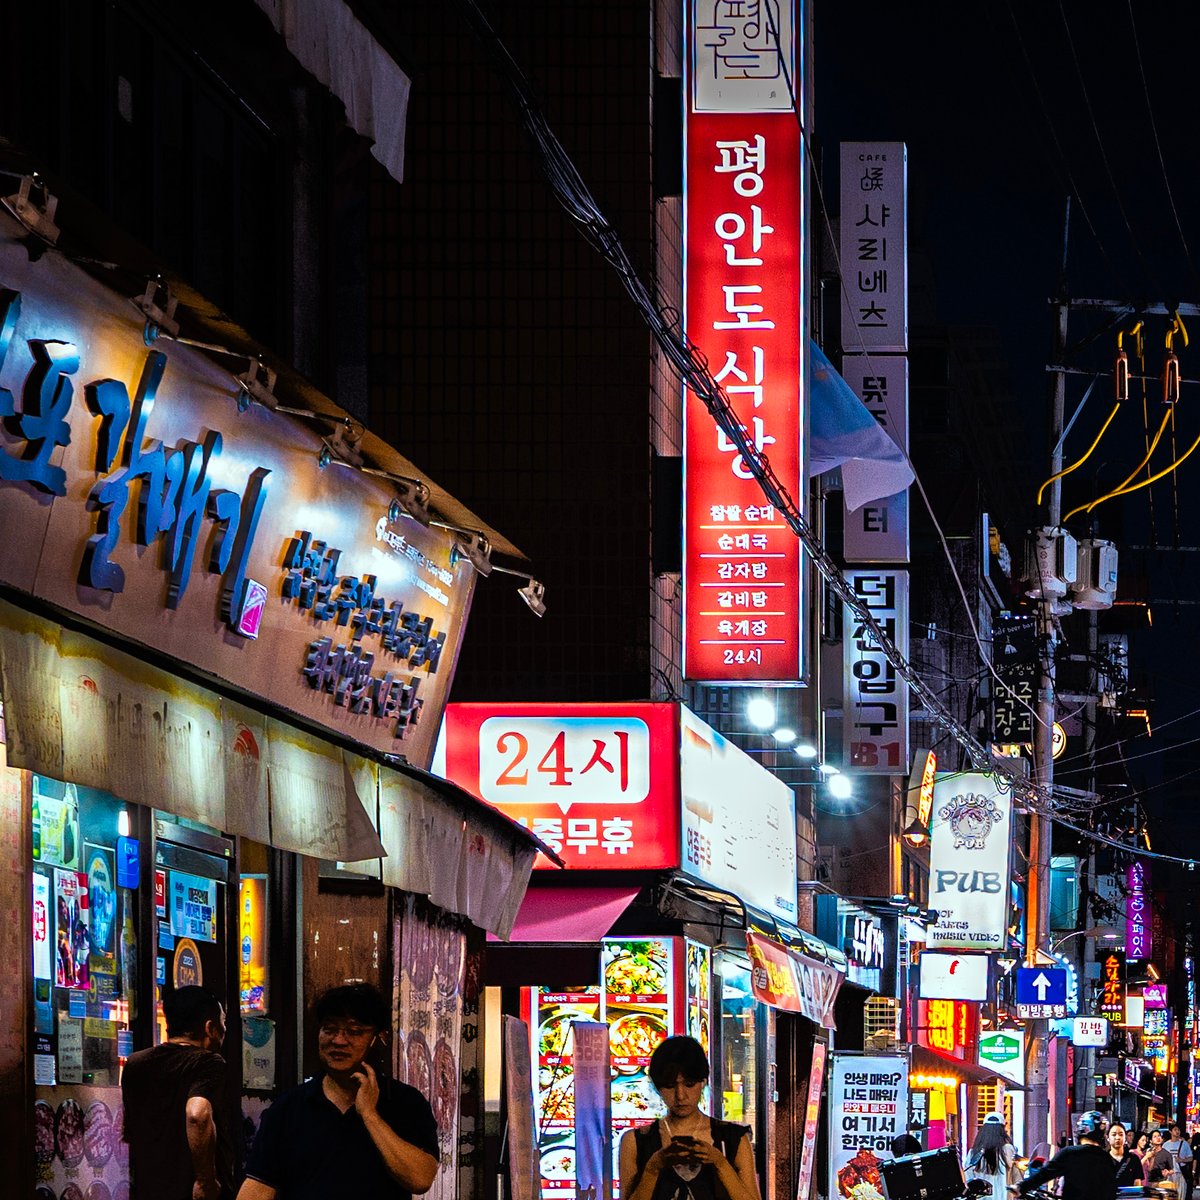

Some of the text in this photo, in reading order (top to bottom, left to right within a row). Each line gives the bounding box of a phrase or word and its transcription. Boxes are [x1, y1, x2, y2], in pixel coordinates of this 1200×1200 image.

[855, 204, 891, 327] 샤리베츠
[713, 134, 775, 479] 평안도식당
[744, 505, 775, 521] 순대
[717, 533, 768, 550] 순대국
[717, 563, 768, 579] 감자탕
[717, 592, 768, 608] 갈비탕
[717, 620, 768, 636] 육개장
[723, 649, 761, 665] 24시
[852, 576, 898, 736] 던전입구
[495, 731, 629, 792] 24시
[851, 742, 900, 766] B1
[518, 817, 634, 855] 중무휴
[953, 840, 985, 850] PUB
[935, 869, 1001, 893] PUB
[968, 932, 1001, 943] VIDEO
[1020, 1004, 1065, 1018] 일방통행
[1102, 1012, 1122, 1021] PUB
[1080, 1022, 1102, 1035] 김밥
[844, 1072, 902, 1086] 인생 매워?
[843, 1088, 898, 1101] 나도 매워!
[842, 1116, 896, 1132] 여기서
[842, 1133, 895, 1151] 한잔해
